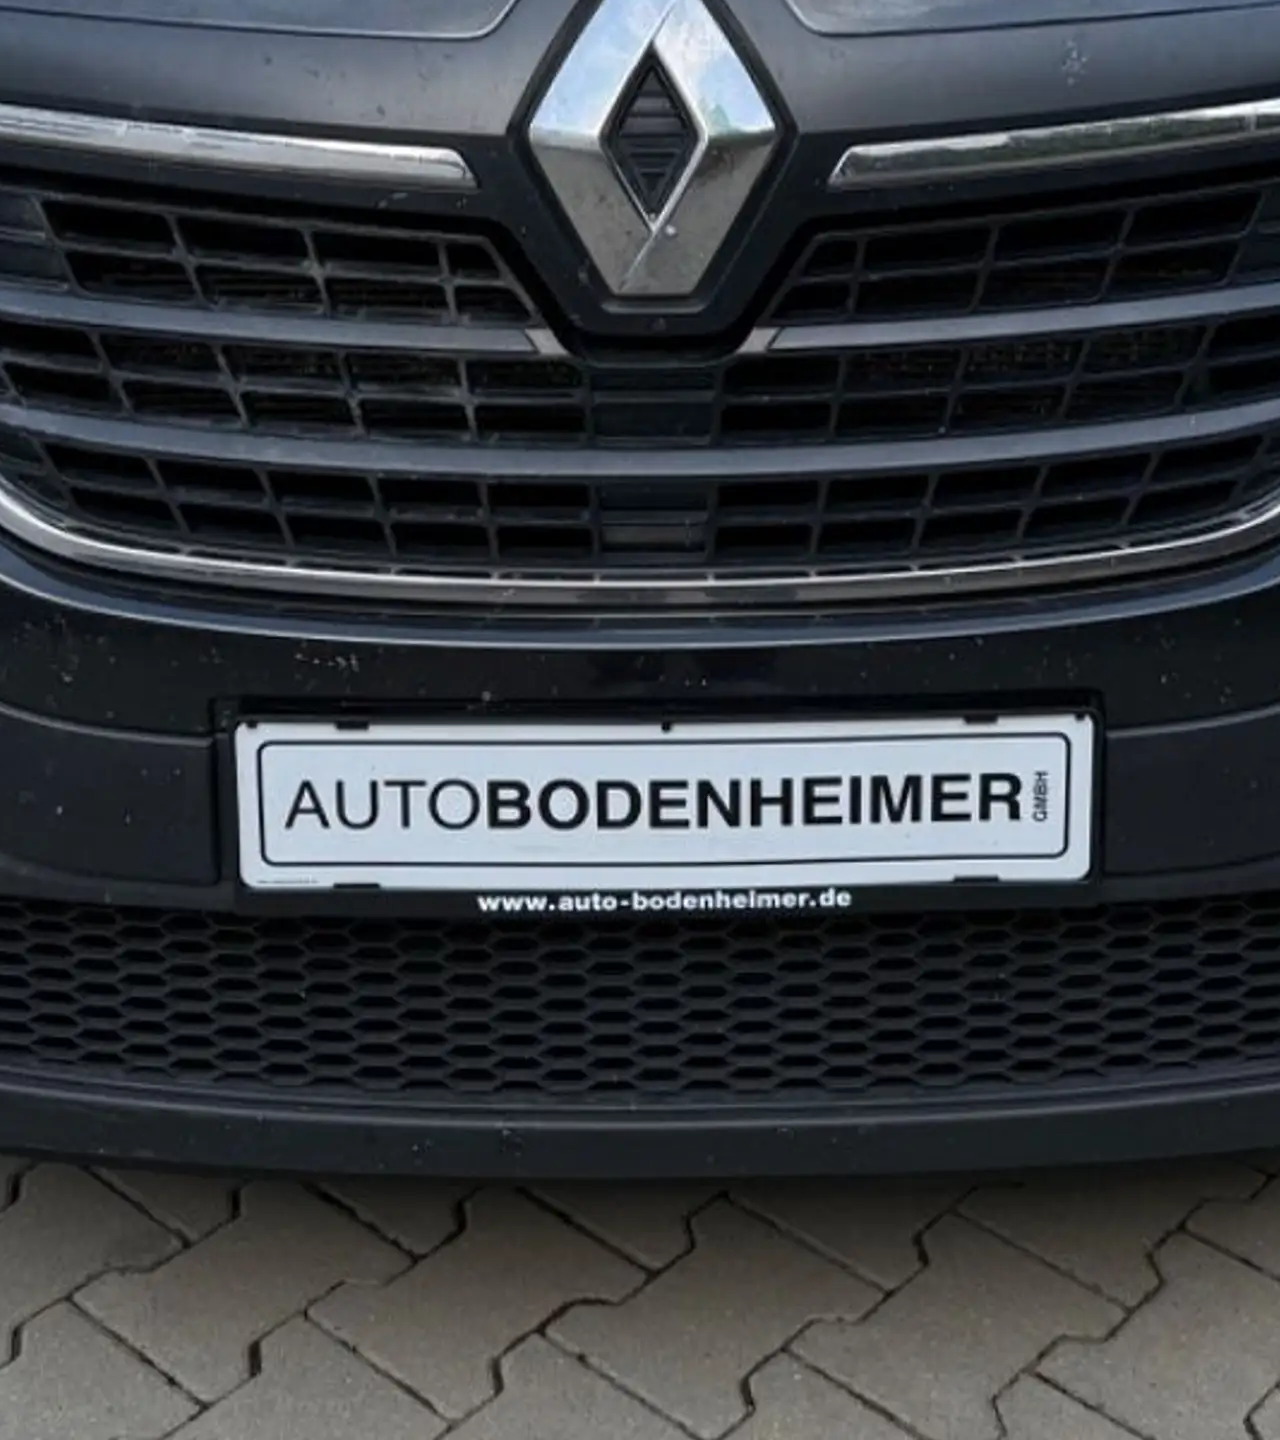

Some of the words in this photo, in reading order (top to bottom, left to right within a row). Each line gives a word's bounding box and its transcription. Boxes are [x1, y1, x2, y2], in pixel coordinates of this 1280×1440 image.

[284, 772, 1023, 831] AUTOBODENHEIMER
[1032, 770, 1049, 823] GMBH
[477, 888, 853, 913] www.auto-bodenheimer.de
